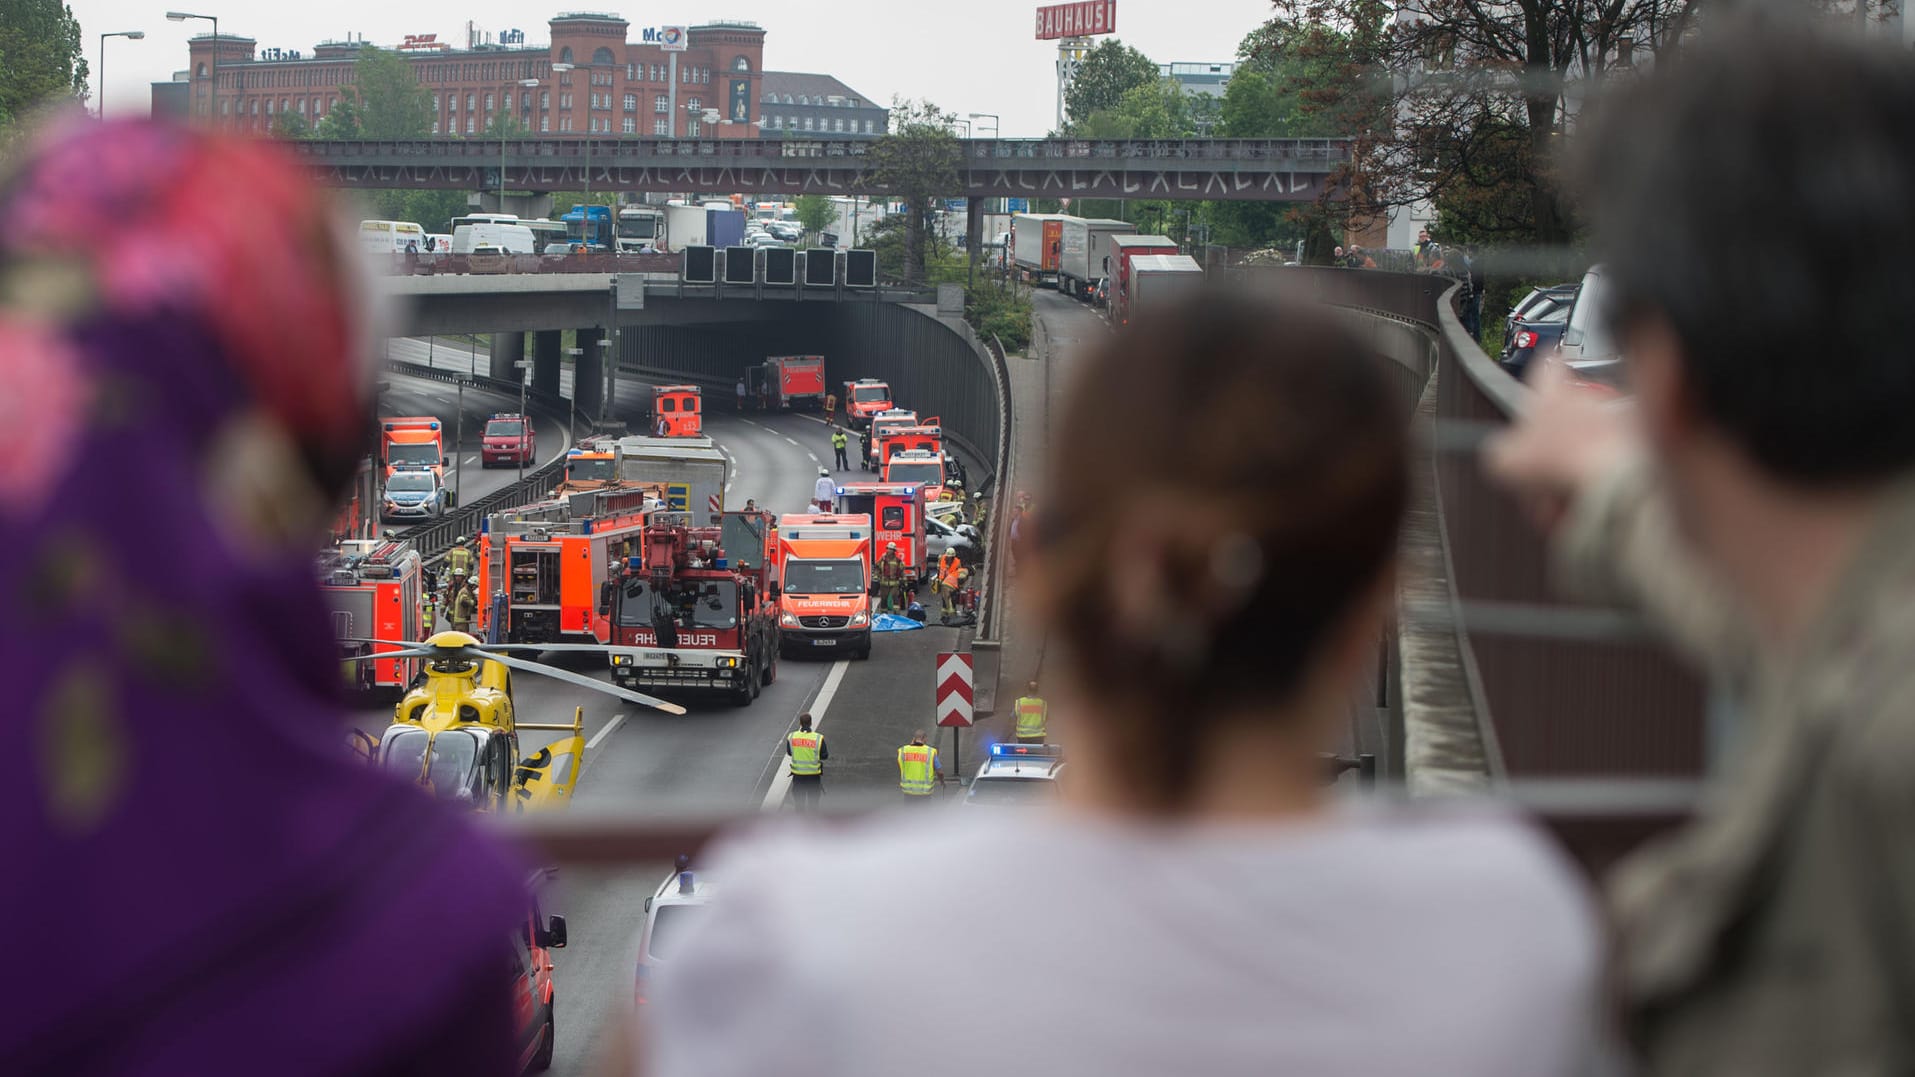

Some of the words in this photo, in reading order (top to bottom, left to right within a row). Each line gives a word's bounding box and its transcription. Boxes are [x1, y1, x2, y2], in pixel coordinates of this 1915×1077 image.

[1036, 4, 1104, 35] BAUHAUS
[876, 530, 903, 541] WEHR
[797, 600, 851, 608] FEUERWEHR
